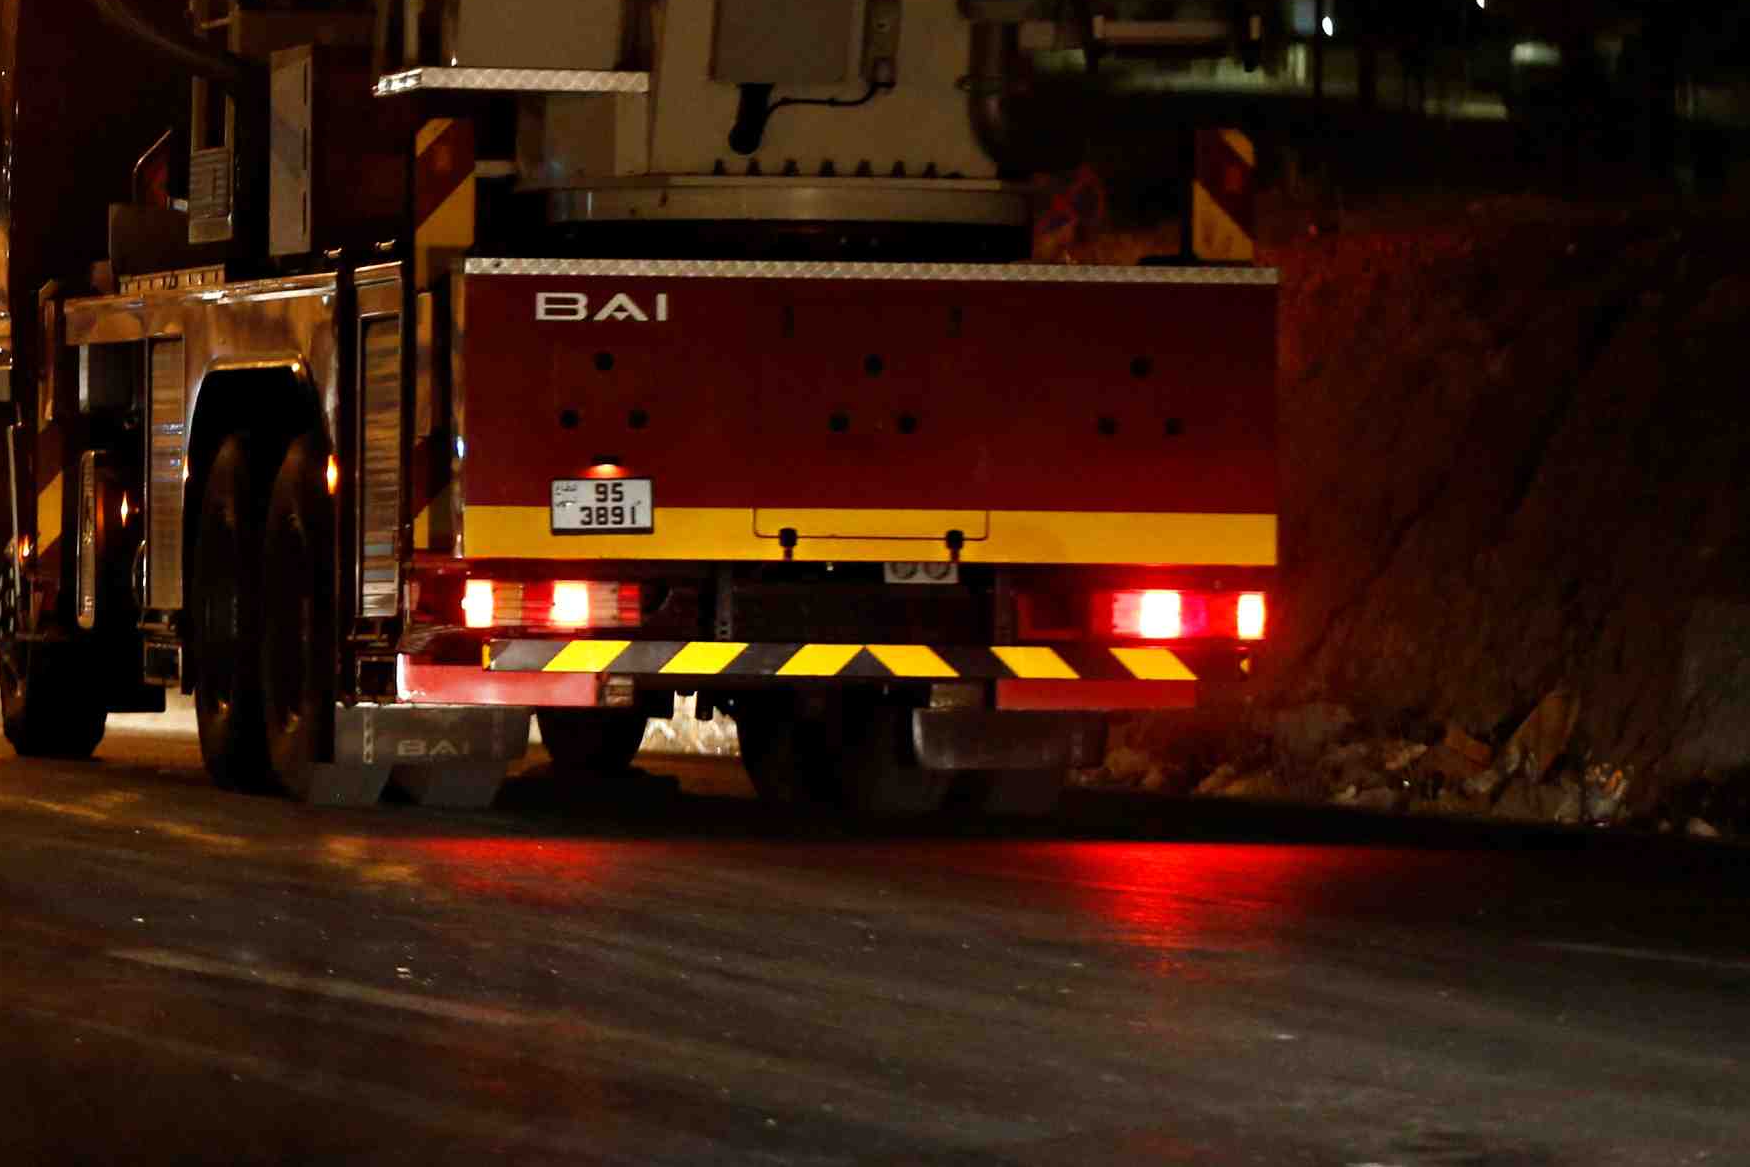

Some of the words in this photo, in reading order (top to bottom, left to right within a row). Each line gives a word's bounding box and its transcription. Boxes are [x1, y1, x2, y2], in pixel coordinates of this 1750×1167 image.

[535, 291, 669, 322] BAI
[594, 482, 625, 503] 95
[579, 505, 637, 526] 3891
[396, 739, 471, 757] BAI
